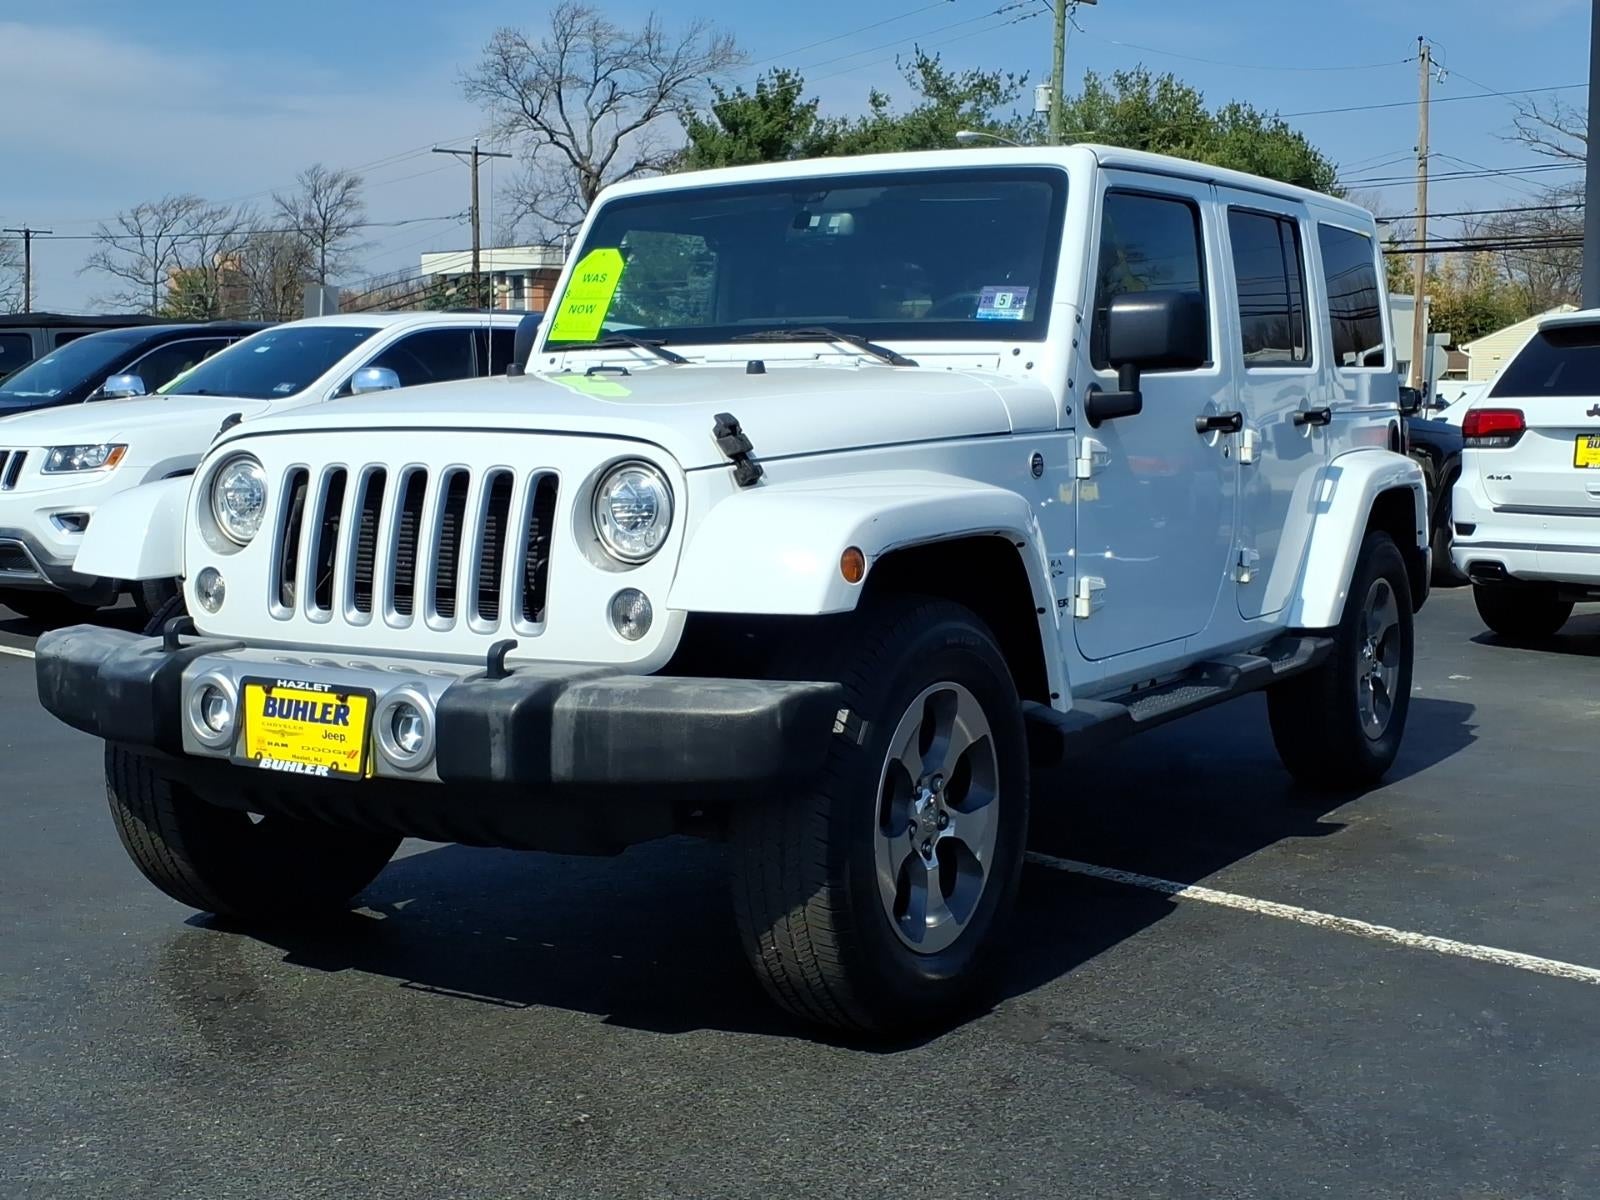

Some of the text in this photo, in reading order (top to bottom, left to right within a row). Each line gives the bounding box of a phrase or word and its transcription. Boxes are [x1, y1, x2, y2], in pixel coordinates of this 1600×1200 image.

[583, 273, 607, 283] WAS
[999, 294, 1007, 306] 5
[568, 304, 597, 314] NOW
[277, 679, 332, 692] HAZLET
[262, 696, 350, 727] BUHLER
[261, 721, 304, 731] CHRYSLER
[321, 729, 347, 743] Jeep
[301, 745, 350, 756] DODGE
[258, 758, 330, 777] BUHLER
